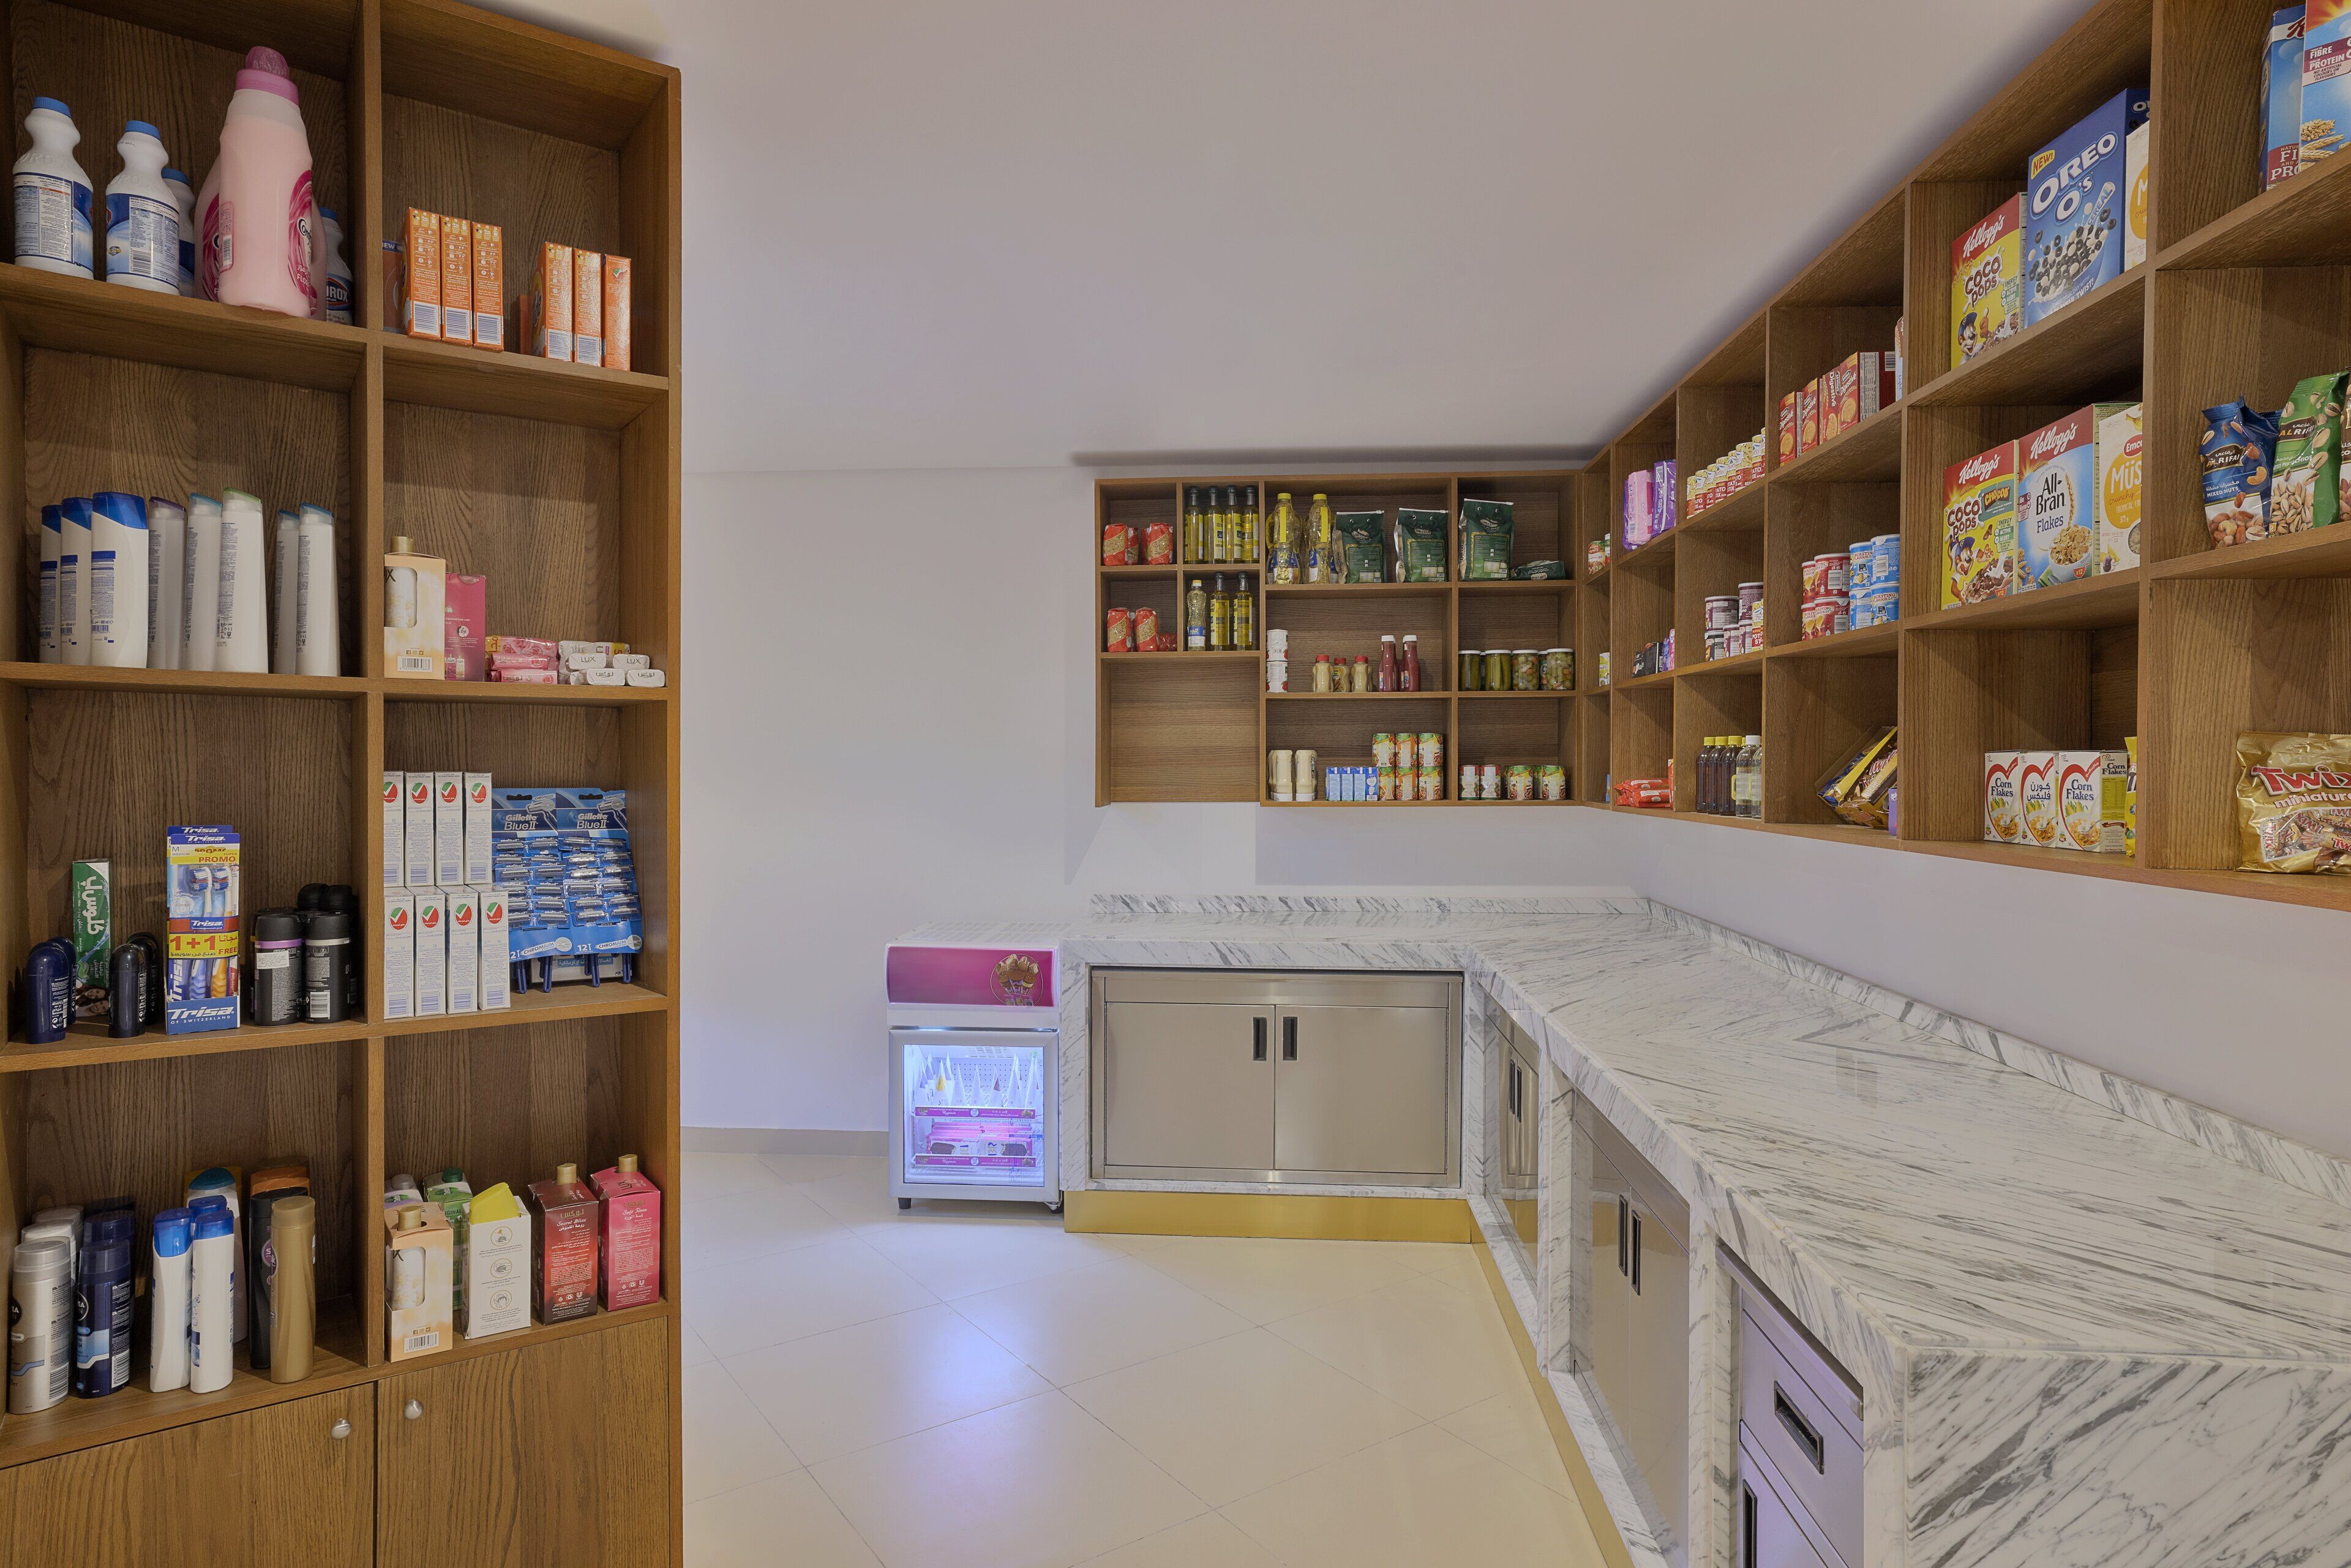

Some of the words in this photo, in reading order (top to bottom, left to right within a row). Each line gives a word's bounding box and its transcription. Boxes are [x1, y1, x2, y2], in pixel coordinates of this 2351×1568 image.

[2310, 46, 2332, 59] FIBRE
[2309, 54, 2344, 70] PROTEIN
[2315, 72, 2336, 81] FLAVOURS
[2033, 152, 2054, 173] NEW!
[2032, 132, 2116, 216] OREO
[2088, 186, 2113, 224] CEREAL
[1963, 214, 2006, 258] Kellogg's
[1965, 255, 2001, 294] COCO
[326, 286, 348, 302] ROX
[2006, 285, 2017, 296] ACTIVE
[2076, 277, 2094, 299] TWIST!
[2006, 293, 2015, 302] ALERT
[2030, 422, 2077, 460] Kellogg's
[2218, 454, 2240, 464] RIFAI
[1959, 454, 2000, 484] Kellogg's
[2112, 460, 2142, 493] MÜS
[2036, 492, 2064, 516] Bran
[2109, 490, 2135, 505] crunchy
[1947, 499, 1981, 527] COCO
[1998, 517, 2012, 526] ENERGY
[2037, 515, 2064, 534] Flakes
[1995, 778, 2012, 789] Corn
[2030, 782, 2050, 792] كورن
[2071, 779, 2093, 791] Corn
[1991, 786, 2014, 797] Flakes
[2027, 792, 2051, 802] فليكس
[2066, 789, 2094, 801] Flakes
[2274, 791, 2351, 808] miniatur
[505, 813, 537, 822] Gillette
[523, 942, 555, 955] CHROMIUM
[599, 940, 626, 948] CHROMIUM
[170, 959, 182, 1000] Tris
[167, 1007, 234, 1019] Trisa
[560, 1209, 584, 1218] لوكس
